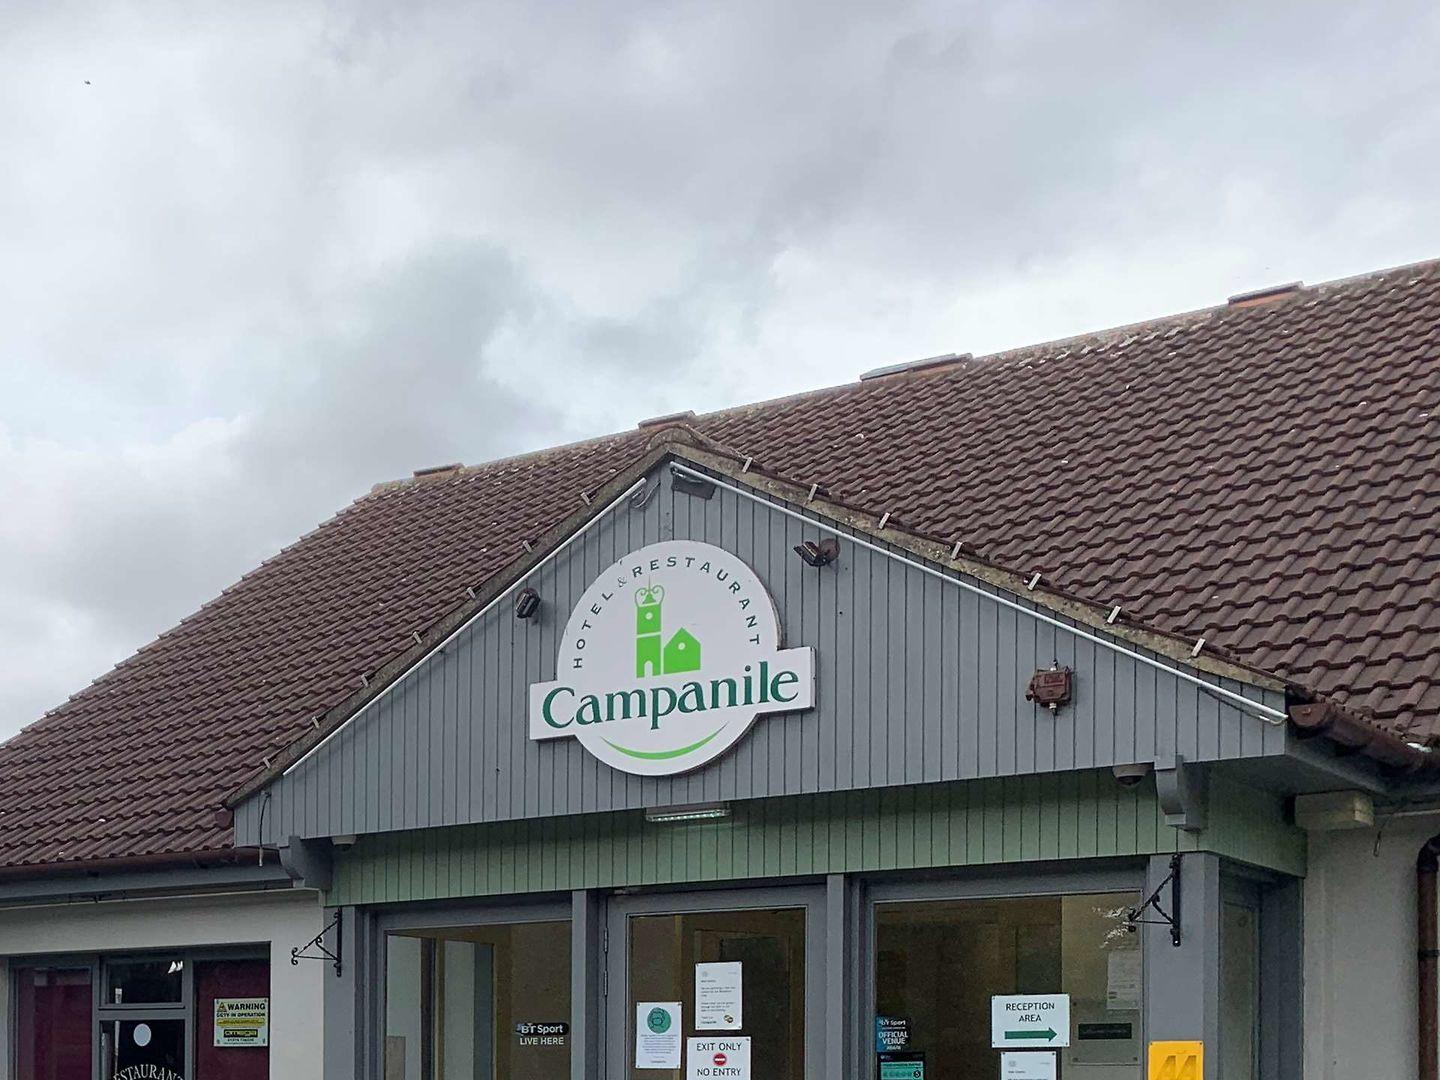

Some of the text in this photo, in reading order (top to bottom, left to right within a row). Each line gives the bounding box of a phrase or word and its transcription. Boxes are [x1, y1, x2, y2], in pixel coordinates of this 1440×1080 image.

[573, 556, 760, 669] HOTEL & RESTAURANT
[542, 661, 799, 730] Campanile
[1005, 1001, 1055, 1012] RECEPTION
[1018, 1014, 1042, 1023] AREA
[521, 1024, 564, 1035] BT Sport
[520, 1037, 564, 1045] LIVE HERE
[696, 1042, 742, 1051] EXIT ONLY
[696, 1068, 742, 1077] NO ENTRY
